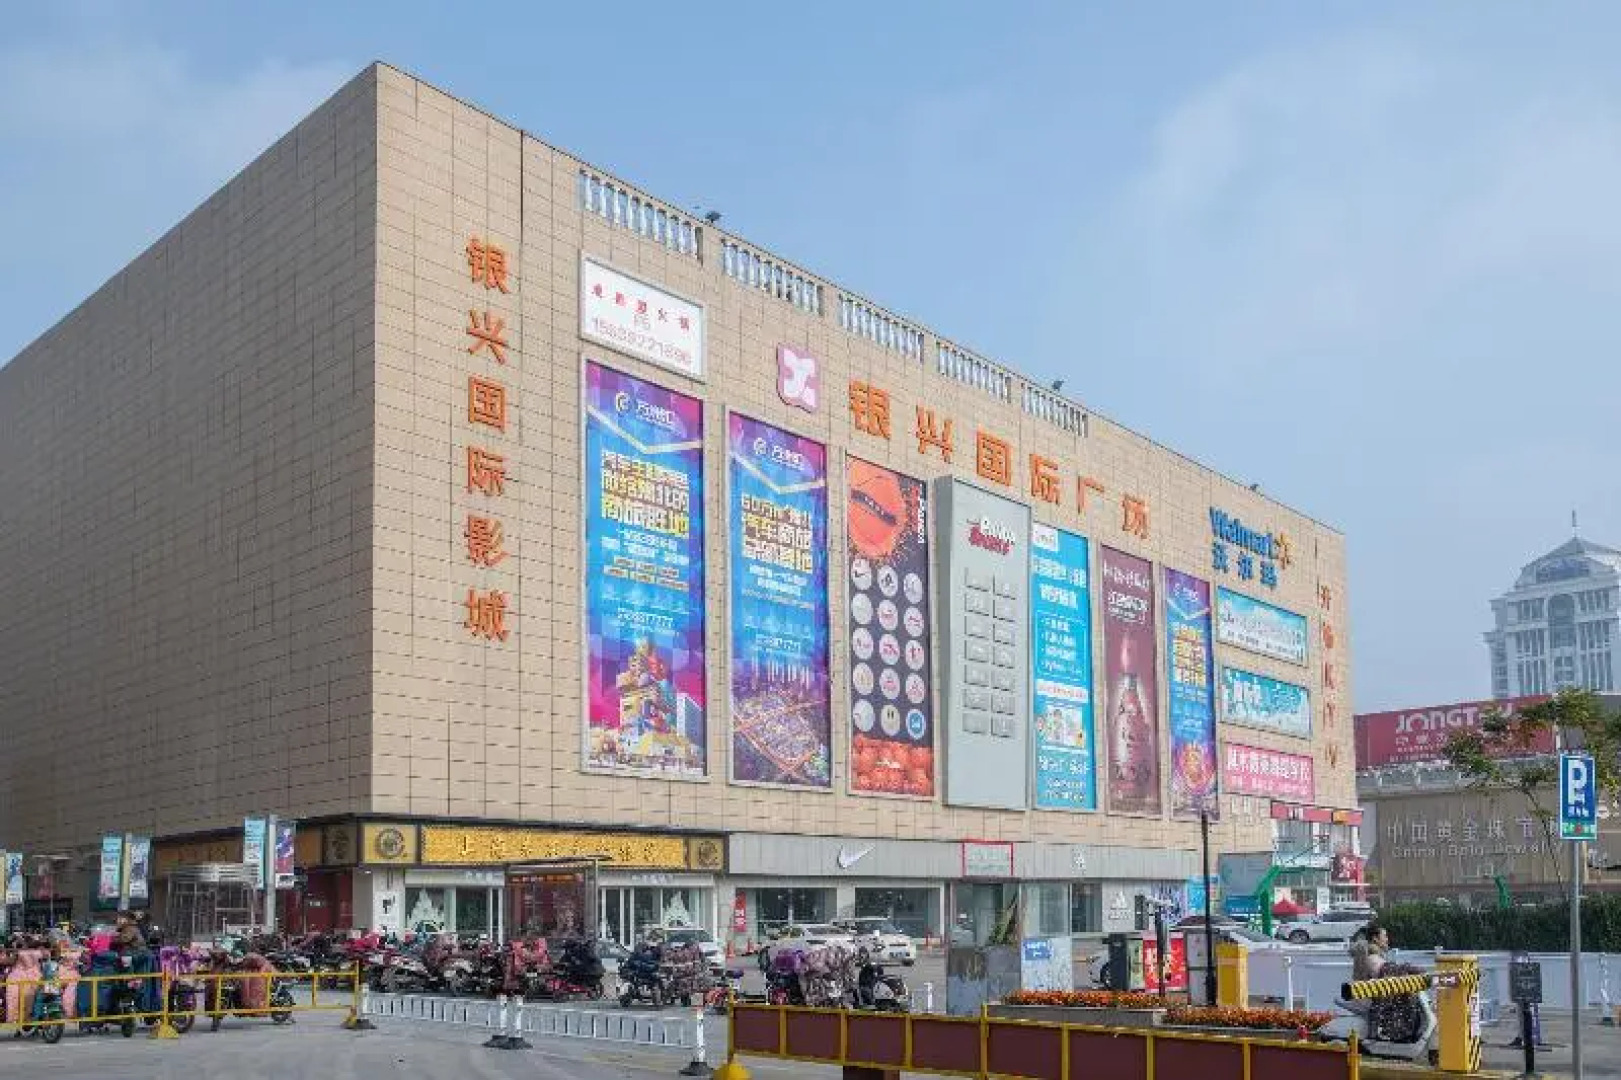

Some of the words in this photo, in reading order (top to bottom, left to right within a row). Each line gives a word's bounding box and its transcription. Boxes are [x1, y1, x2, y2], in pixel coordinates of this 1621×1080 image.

[466, 236, 508, 643] 银兴国际影城
[848, 379, 1150, 540] 银兴国际广场
[1209, 505, 1276, 560] Walmart
[1211, 541, 1278, 588] 沃尔玛
